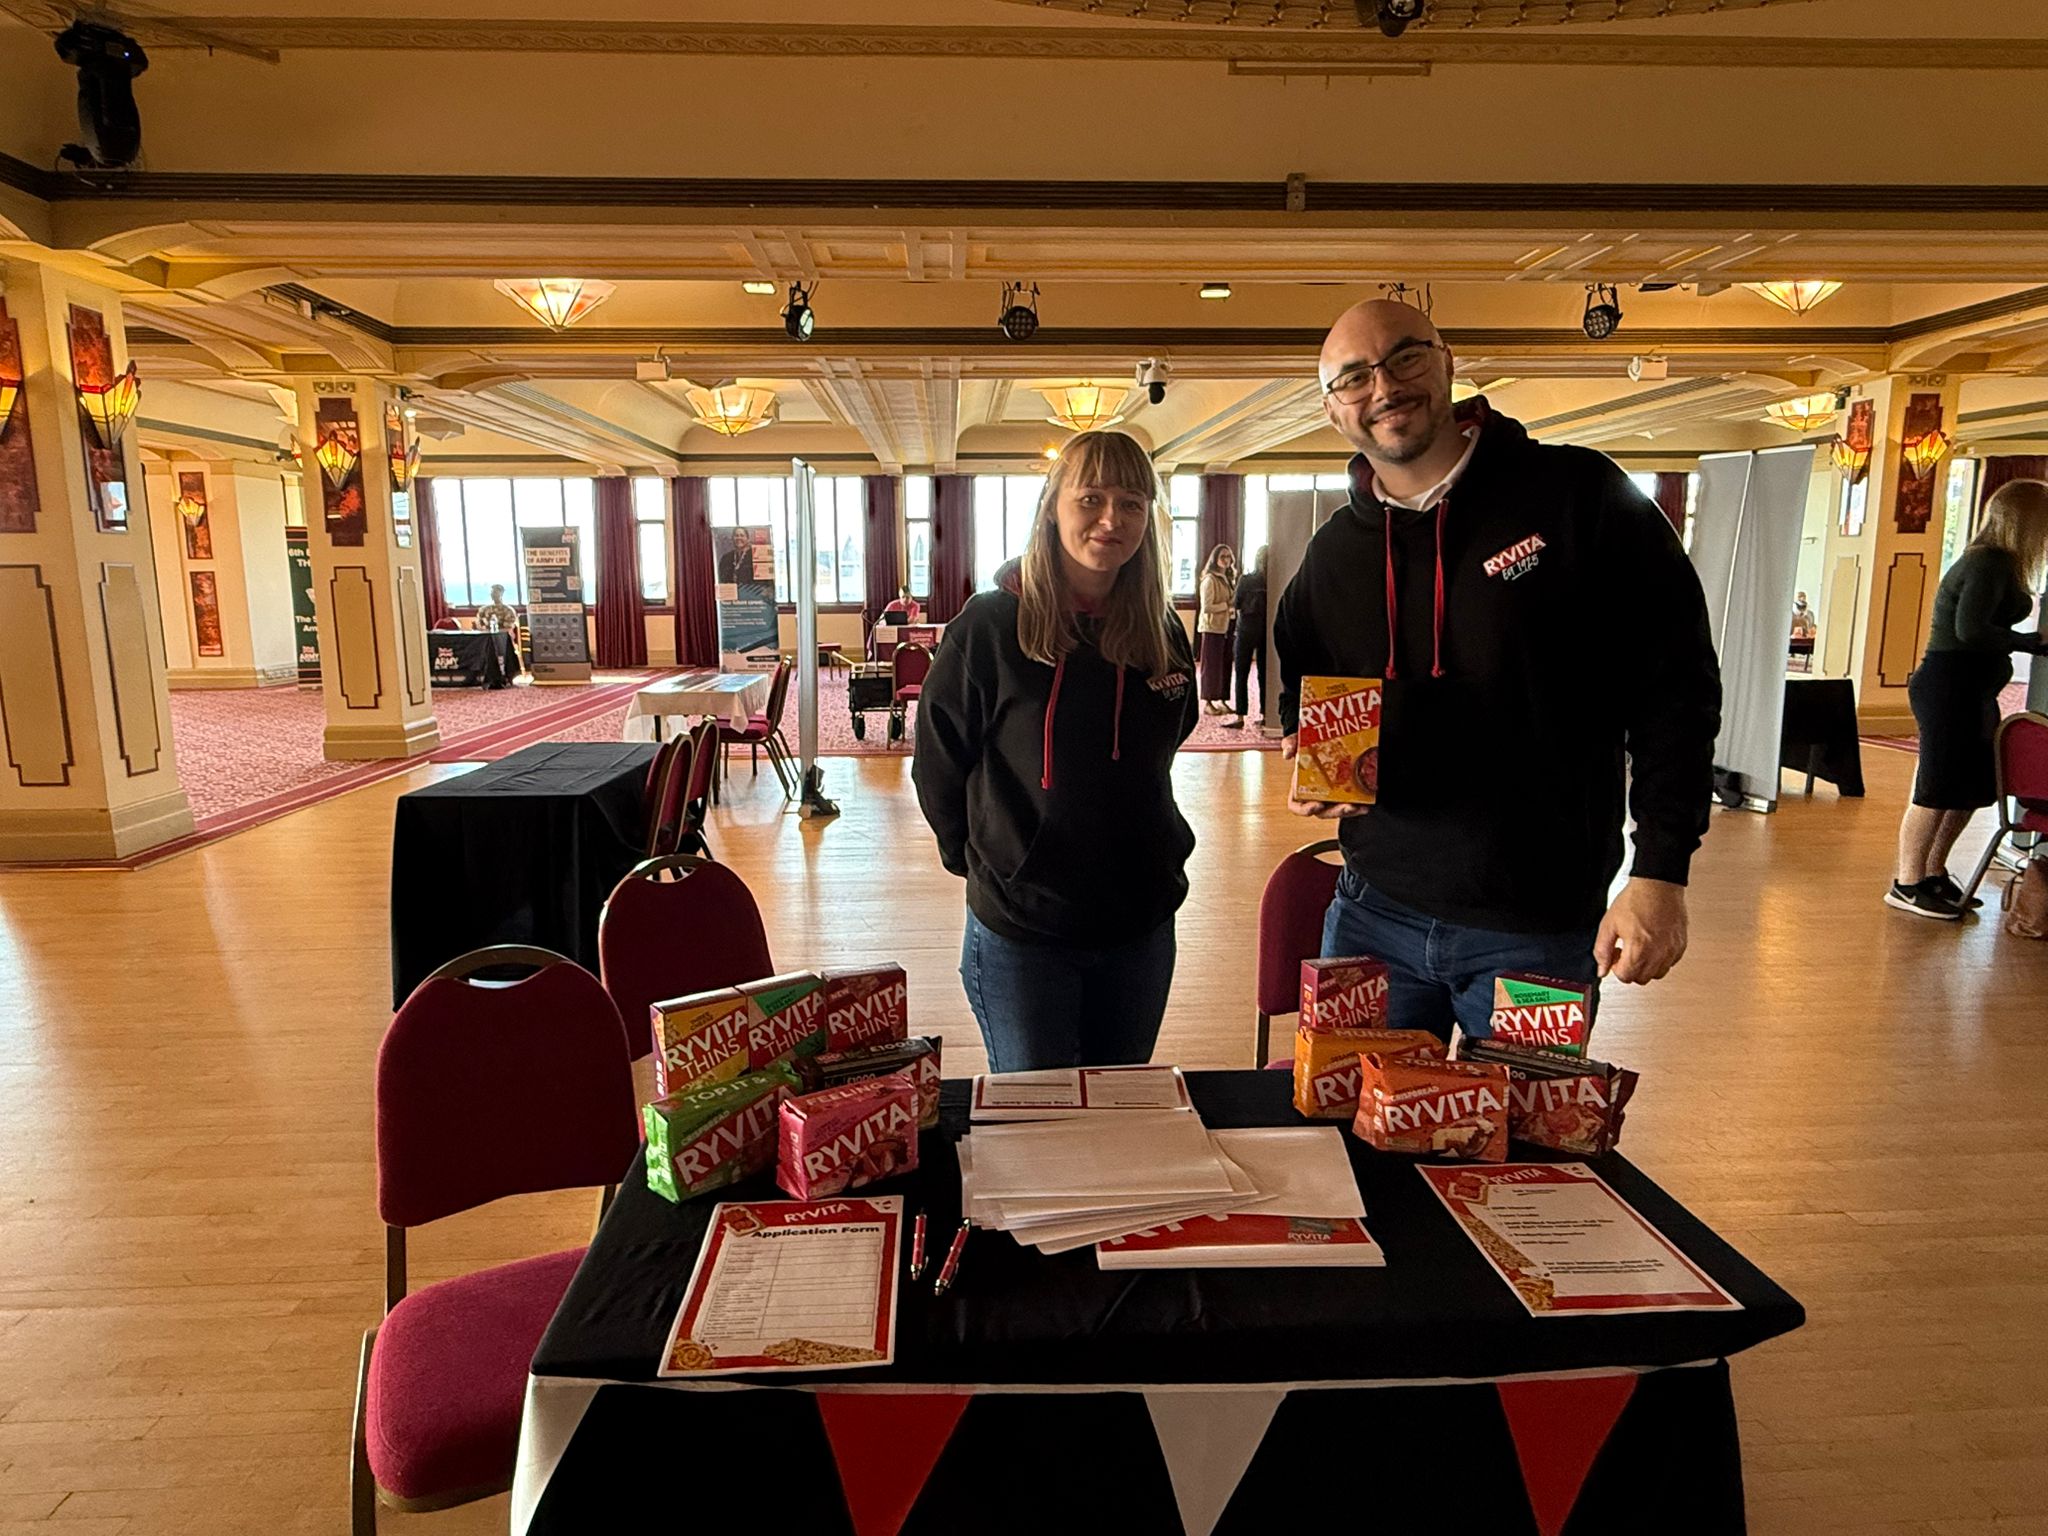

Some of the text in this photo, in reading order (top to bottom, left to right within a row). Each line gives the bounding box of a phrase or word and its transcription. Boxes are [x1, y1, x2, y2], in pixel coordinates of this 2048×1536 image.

[1482, 535, 1547, 576] RYVITA
[435, 656, 459, 669] ARMY
[1298, 688, 1382, 729] RYVITA
[1312, 713, 1373, 741] THINS
[827, 982, 907, 1035] RYVITA
[1313, 975, 1390, 1024] RYVITA
[1327, 1001, 1381, 1029] THINS
[748, 991, 825, 1051] RYVITA
[843, 1008, 900, 1044] THINS
[1491, 1003, 1585, 1033] RYVITA
[665, 1010, 748, 1073] RYVITA
[763, 1017, 819, 1058] THINS
[1507, 1028, 1572, 1047] THINS
[681, 1037, 741, 1080] THINS
[684, 1086, 729, 1104] TOP
[730, 1080, 749, 1090] IT
[805, 1082, 885, 1106] FEELING
[1383, 1087, 1504, 1133] RYVITA
[1510, 1076, 1608, 1113] VITA
[803, 1102, 912, 1181] RYVITA
[1489, 1167, 1549, 1185] RYVITA
[783, 1202, 852, 1223] RYVITA
[750, 1225, 880, 1239] Application Form
[1287, 1232, 1332, 1241] RYVITA
